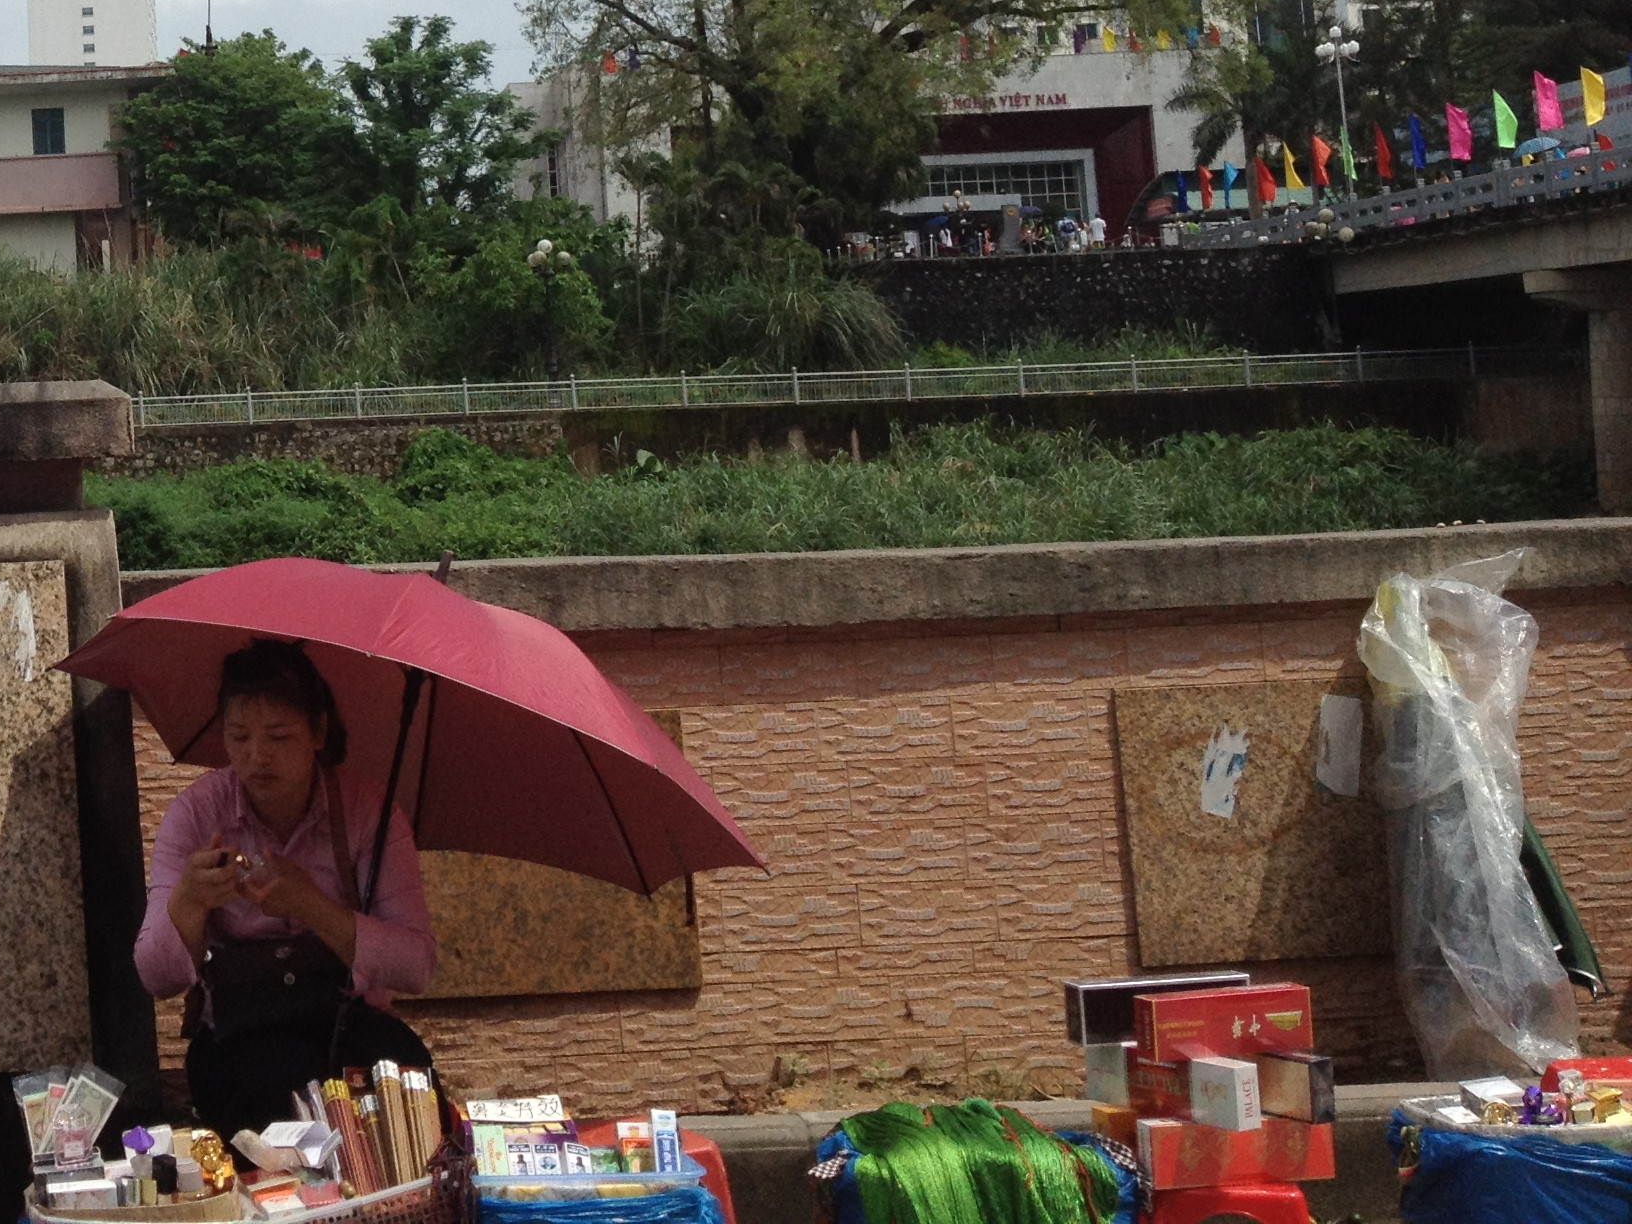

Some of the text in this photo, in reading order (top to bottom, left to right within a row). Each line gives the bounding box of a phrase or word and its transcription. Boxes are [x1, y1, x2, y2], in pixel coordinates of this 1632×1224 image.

[999, 92, 1031, 109] VIỆT
[1035, 93, 1067, 106] NAM
[1241, 1078, 1254, 1120] PALACE
